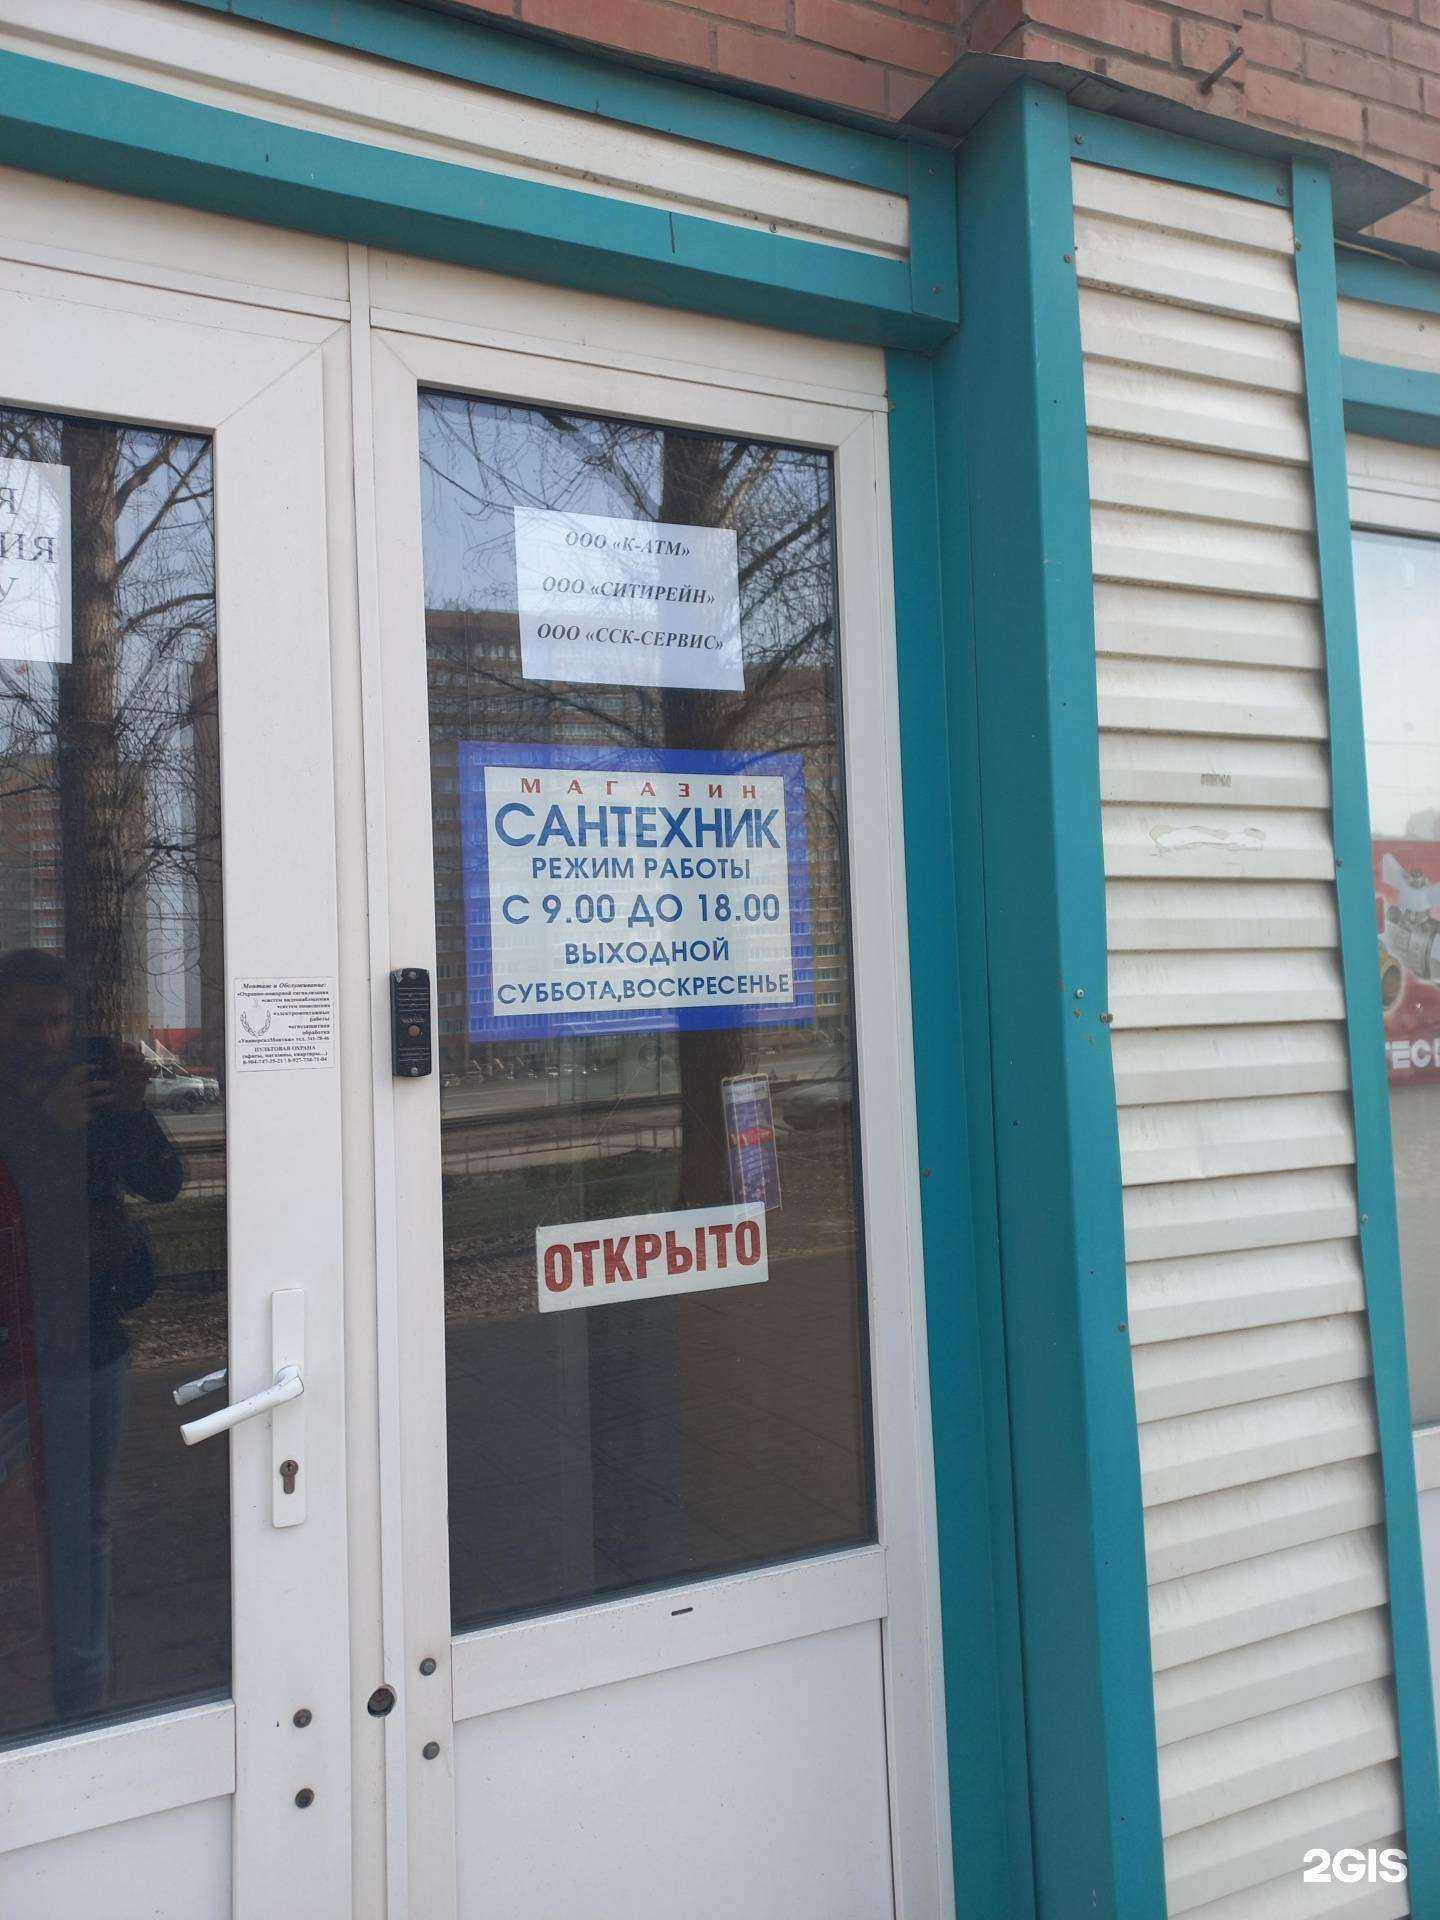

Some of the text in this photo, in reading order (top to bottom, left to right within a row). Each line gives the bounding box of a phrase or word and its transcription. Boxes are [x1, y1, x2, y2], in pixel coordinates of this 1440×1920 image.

[565, 531, 690, 557] ООО «К-АТМ»
[543, 576, 716, 604] ООО «СИТИРЕЙН»
[537, 623, 724, 651] ООО «ССК-СЕРВИС»
[521, 778, 756, 799] МАГАЗИН
[495, 802, 781, 849] САНТЕХНИК
[532, 857, 751, 879] РЕЖИМ РАБОТЫ
[502, 893, 780, 928] С 9.00 ДО 18.00
[565, 937, 730, 967] ВЫХОДНОЙ
[544, 1220, 761, 1292] ОТКРЫТО
